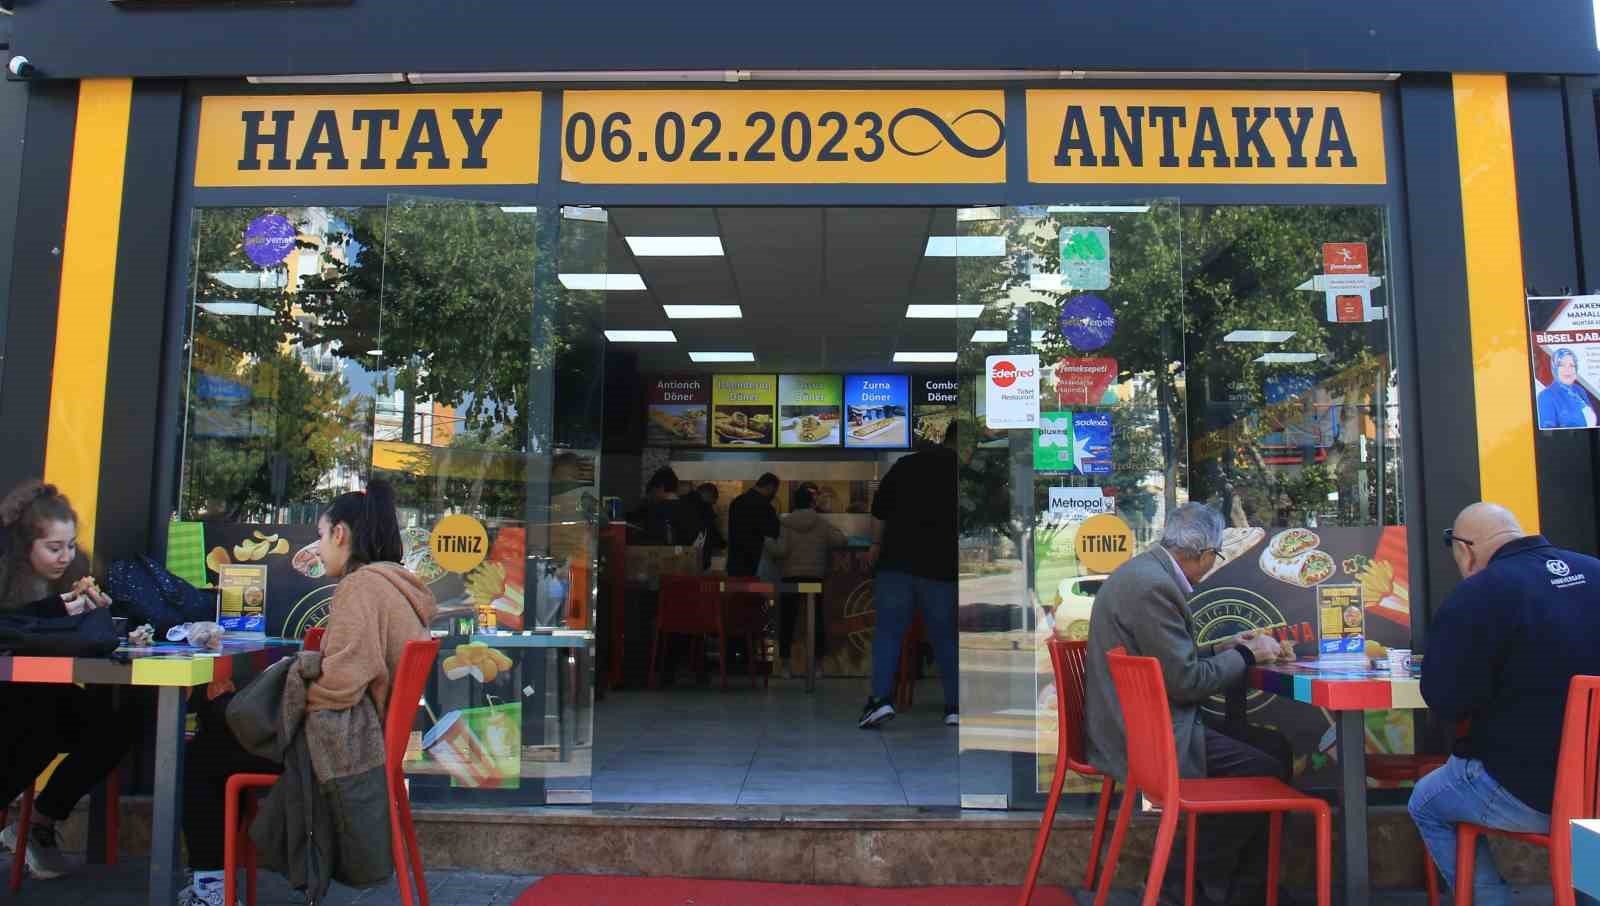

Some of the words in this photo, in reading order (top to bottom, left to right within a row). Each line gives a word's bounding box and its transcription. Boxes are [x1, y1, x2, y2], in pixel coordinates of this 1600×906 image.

[238, 108, 503, 171] HATAY
[565, 111, 885, 163] 06.02.2023
[1054, 105, 1358, 168] ANTAKYA
[1536, 332, 1574, 343] BİRSEL
[991, 368, 1034, 378] Edenred
[657, 380, 701, 390] Antionch
[863, 380, 890, 390] Zurna
[664, 391, 694, 401] Döner
[862, 391, 891, 401] Döner
[928, 391, 958, 401] Döner
[1074, 417, 1108, 426] sodexo
[1051, 497, 1103, 510] Metropol
